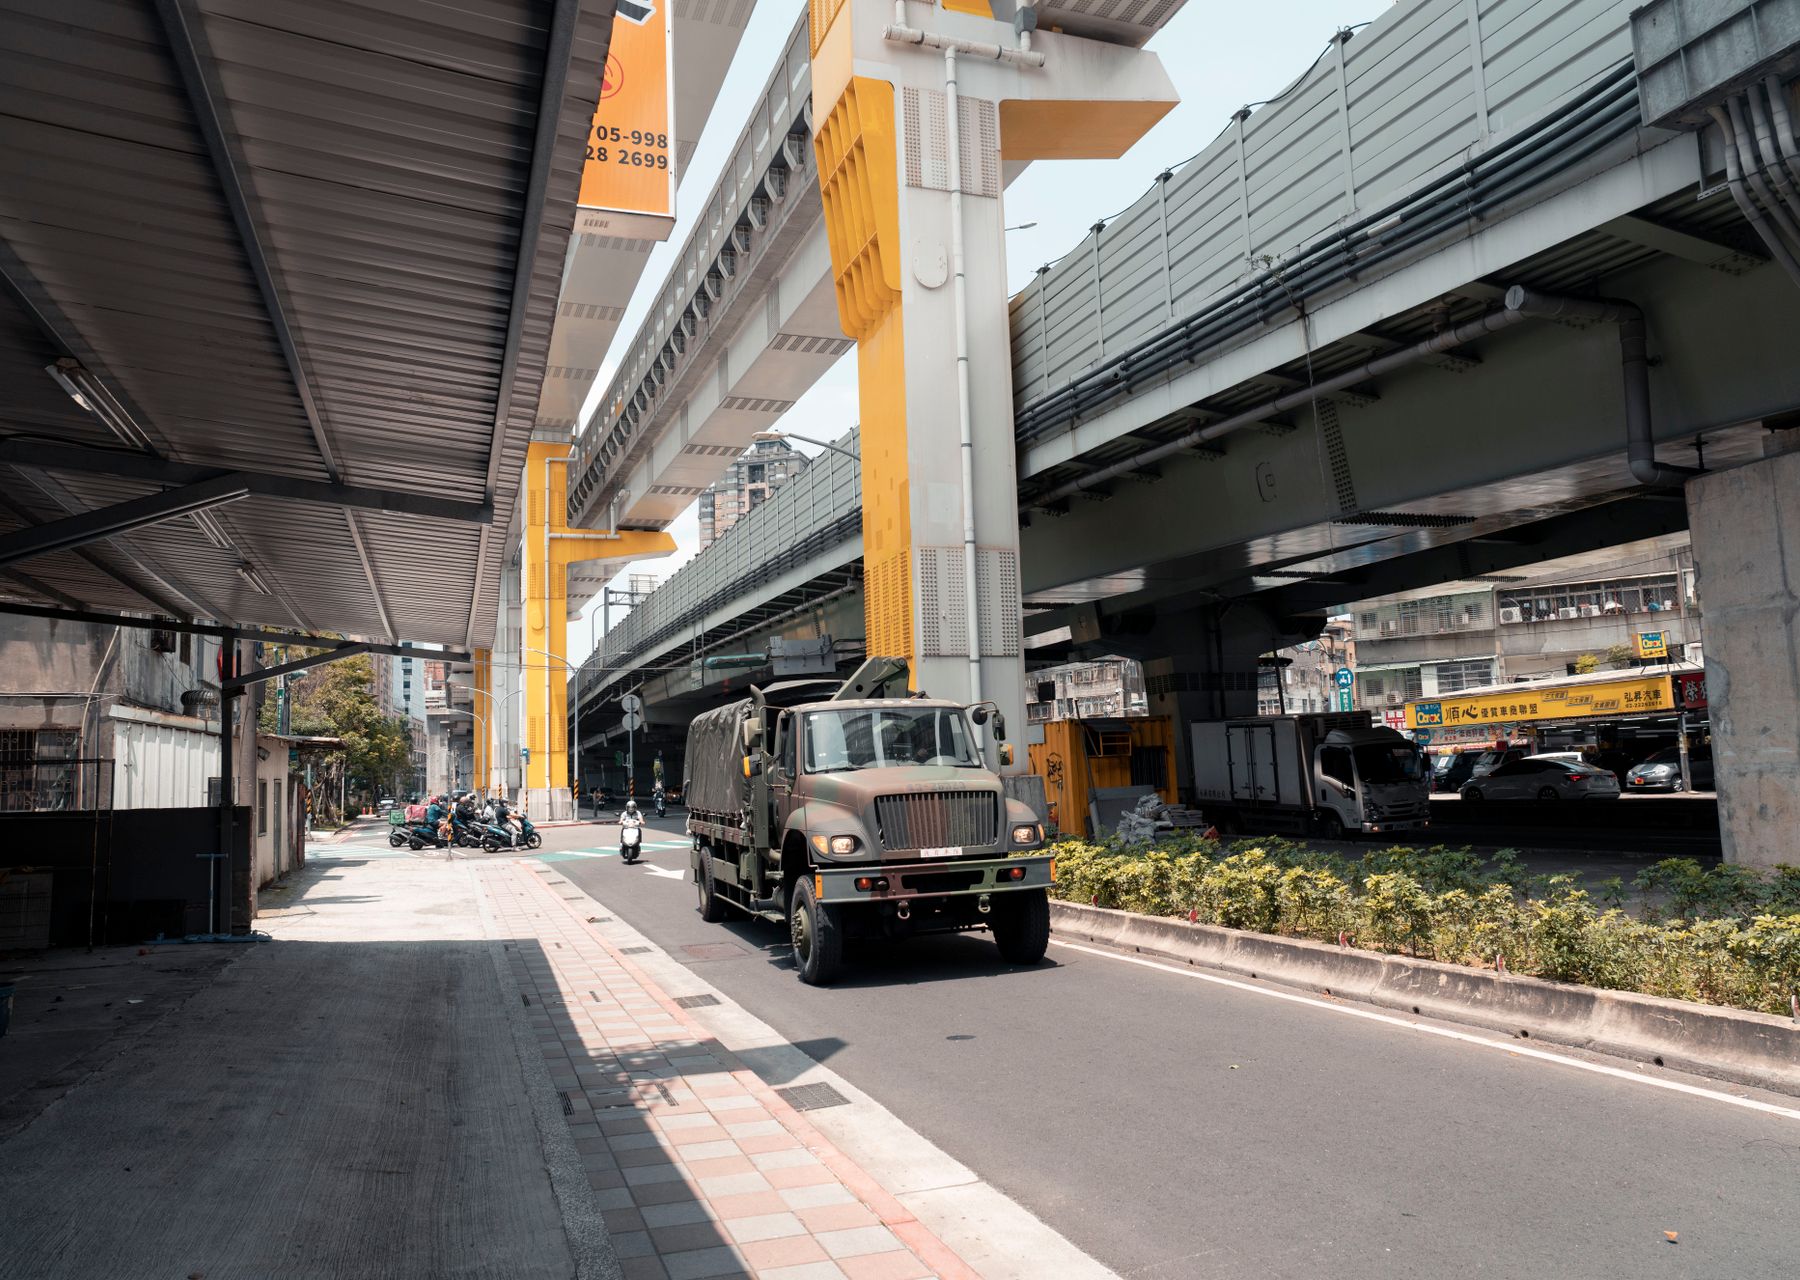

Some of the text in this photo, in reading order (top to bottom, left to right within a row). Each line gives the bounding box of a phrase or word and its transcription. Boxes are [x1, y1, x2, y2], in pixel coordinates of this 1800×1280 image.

[590, 125, 668, 148] 05-998
[586, 145, 668, 169] 28 2699
